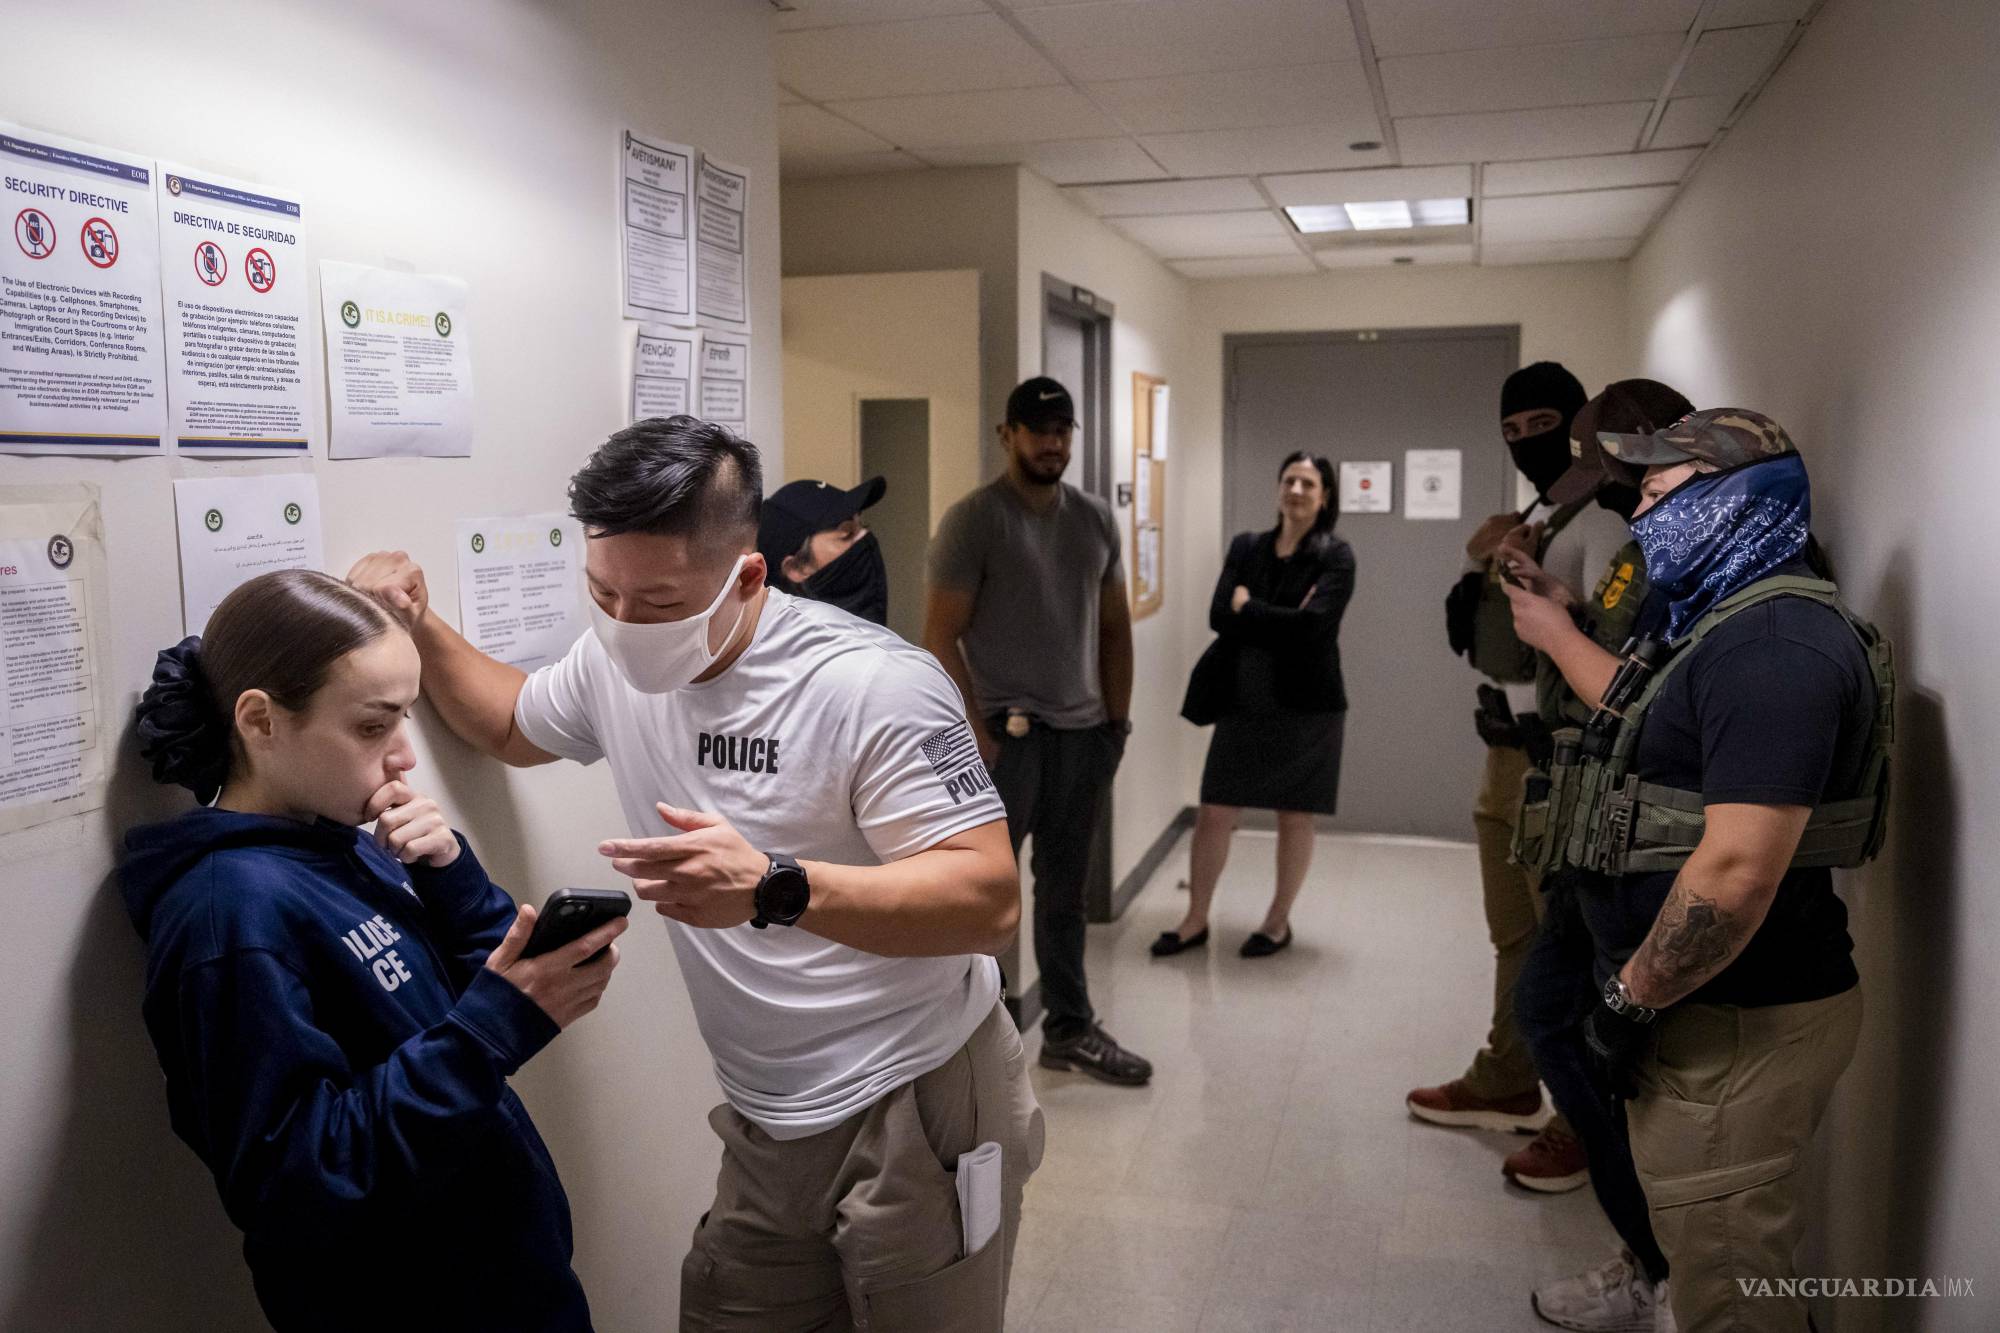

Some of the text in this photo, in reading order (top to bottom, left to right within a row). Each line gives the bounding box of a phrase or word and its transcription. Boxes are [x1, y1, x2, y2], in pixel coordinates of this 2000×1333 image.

[132, 170, 147, 180] EOIR
[5, 177, 128, 213] SECURITY DIRECTIVE
[174, 211, 296, 245] DIRECTIVA DE SEGURIDAD
[2, 277, 13, 285] The
[15, 279, 26, 287] Use
[36, 282, 70, 292] Electronic
[72, 286, 96, 296] Devices
[113, 292, 142, 303] Recording
[6, 288, 41, 300] Capabilities
[30, 303, 56, 313] Laptops
[68, 307, 80, 316] Any
[82, 308, 113, 320] Recording
[115, 312, 139, 322] Devices)
[202, 305, 233, 314] dispositivos
[0, 309, 35, 321] Photograph
[46, 315, 70, 324] Record
[92, 320, 127, 330] Courtrooms
[136, 325, 147, 334] Any
[15, 322, 52, 333] Immigration
[54, 327, 73, 335] Court
[75, 329, 98, 337] Spaces
[90, 340, 124, 350] Conference
[237, 337, 263, 345] dispositivo
[25, 345, 49, 356] Waiting
[84, 350, 106, 360] Strictly
[245, 346, 260, 354] dentro
[698, 732, 780, 774] POLICE
[341, 914, 402, 964] LICE
[372, 950, 412, 992] CE
